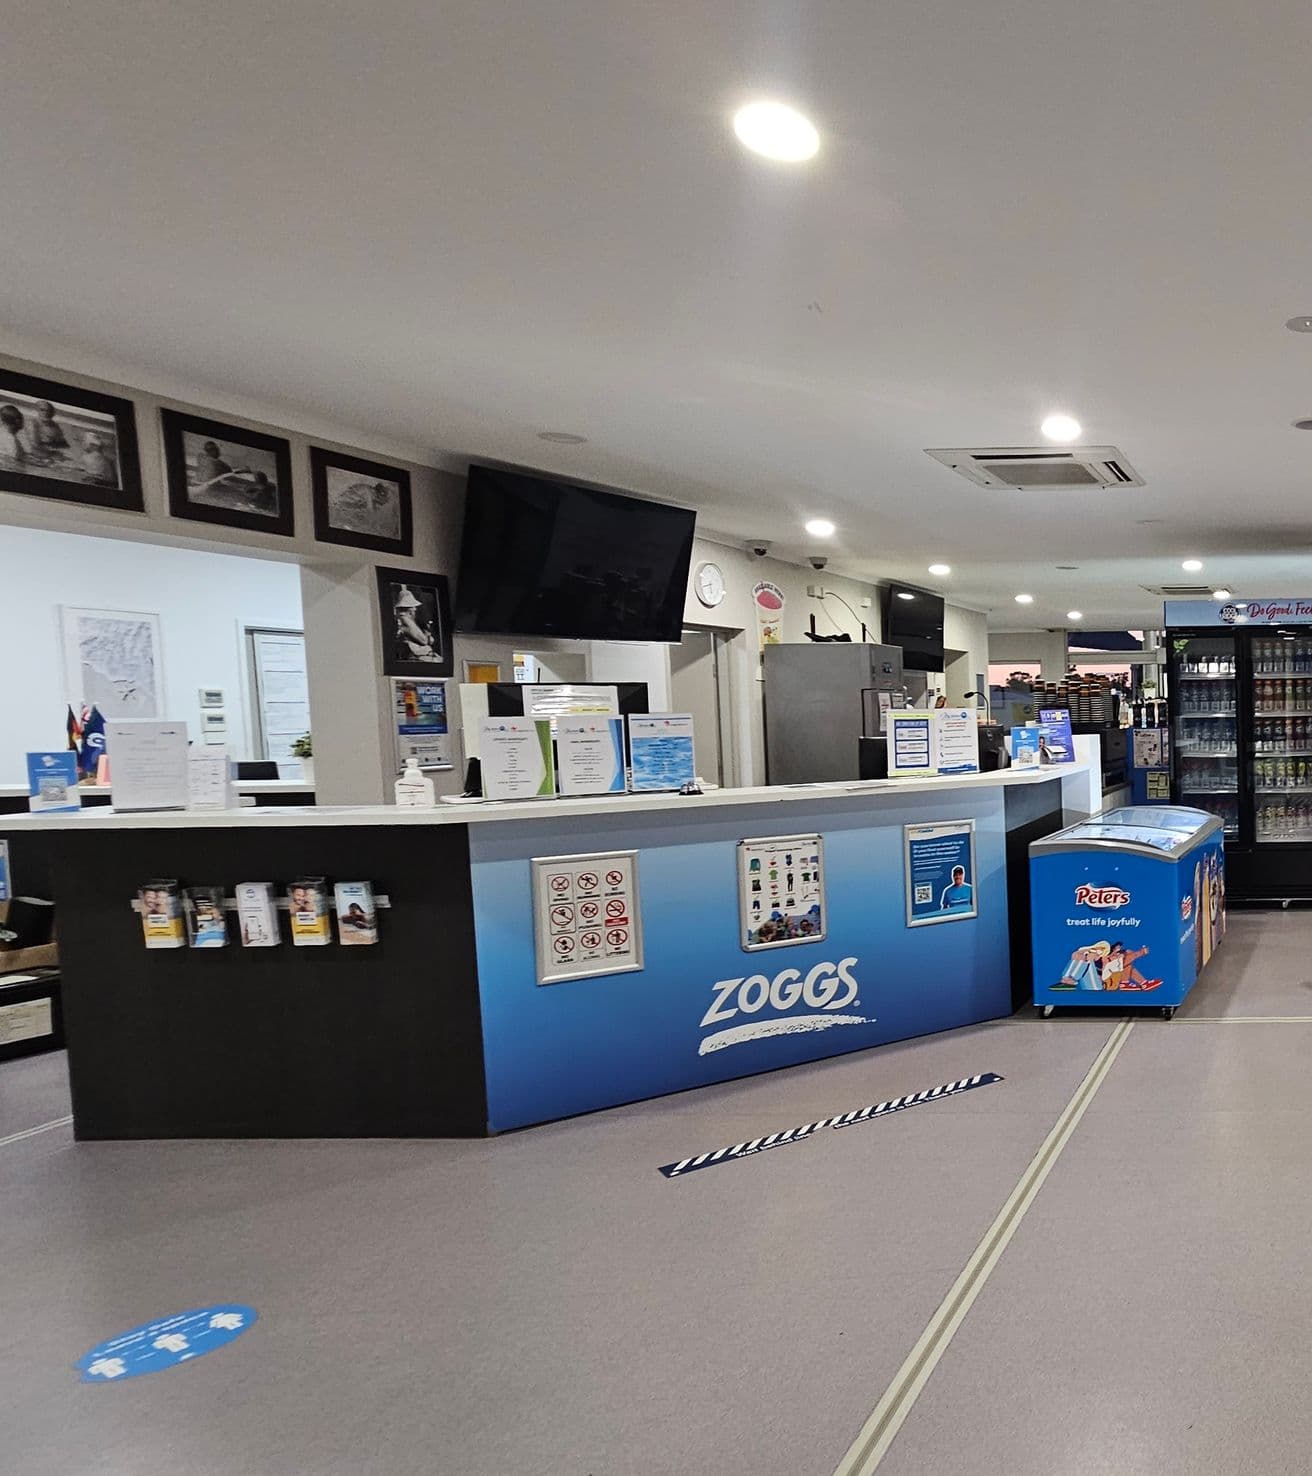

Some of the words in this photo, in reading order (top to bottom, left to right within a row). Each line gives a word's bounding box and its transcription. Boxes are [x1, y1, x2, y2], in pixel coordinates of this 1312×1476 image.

[1247, 602, 1264, 618] Do
[417, 686, 442, 695] WORK
[421, 695, 442, 703] WITH
[433, 704, 444, 712] US
[1076, 886, 1129, 905] Peters
[1066, 918, 1090, 926] treat
[1092, 917, 1106, 926] life
[1107, 917, 1141, 928] joyfully
[700, 957, 860, 1028] ZOGGS
